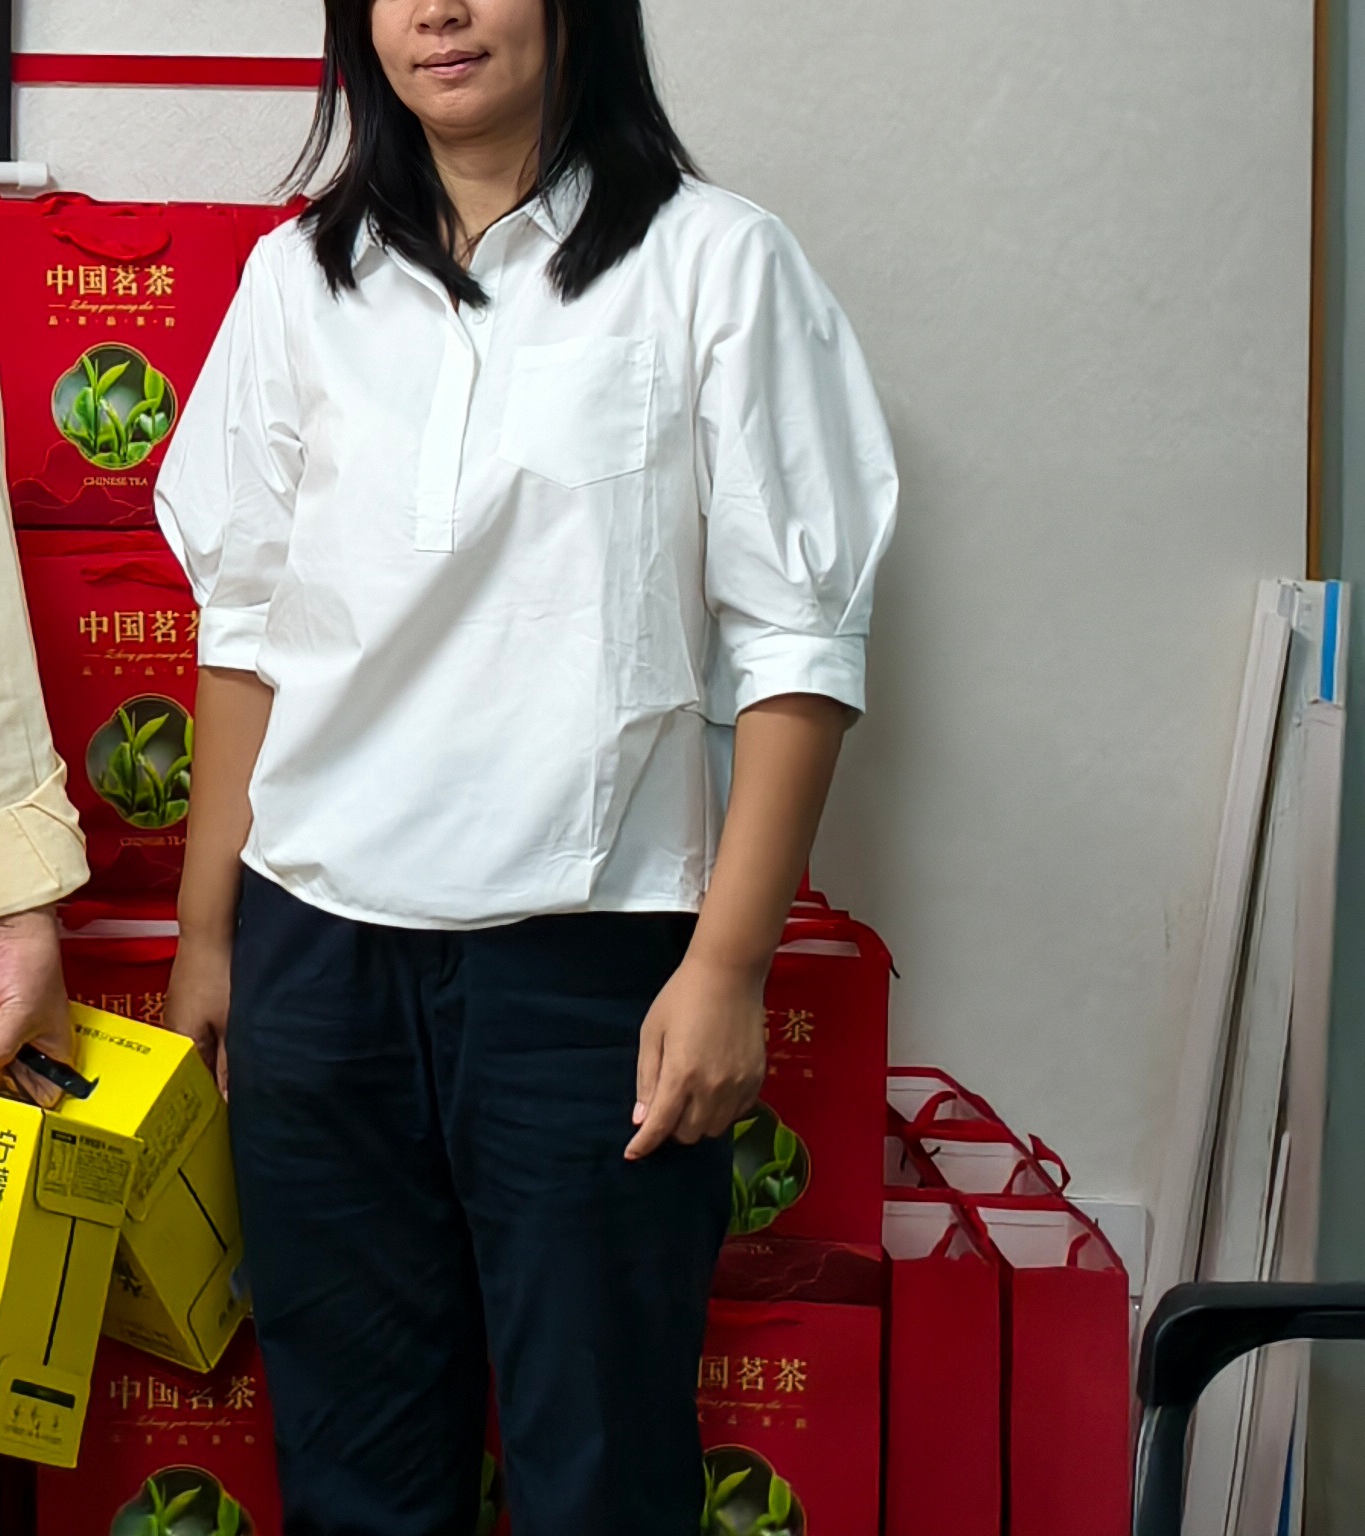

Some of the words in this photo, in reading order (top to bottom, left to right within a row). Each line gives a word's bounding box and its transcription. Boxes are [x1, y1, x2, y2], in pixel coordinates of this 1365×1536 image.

[46, 264, 176, 296] 中国茗茶
[83, 477, 127, 487] CHINESE
[129, 478, 149, 487] TEA
[77, 992, 167, 1024] 国茗
[765, 1009, 815, 1042] 茶
